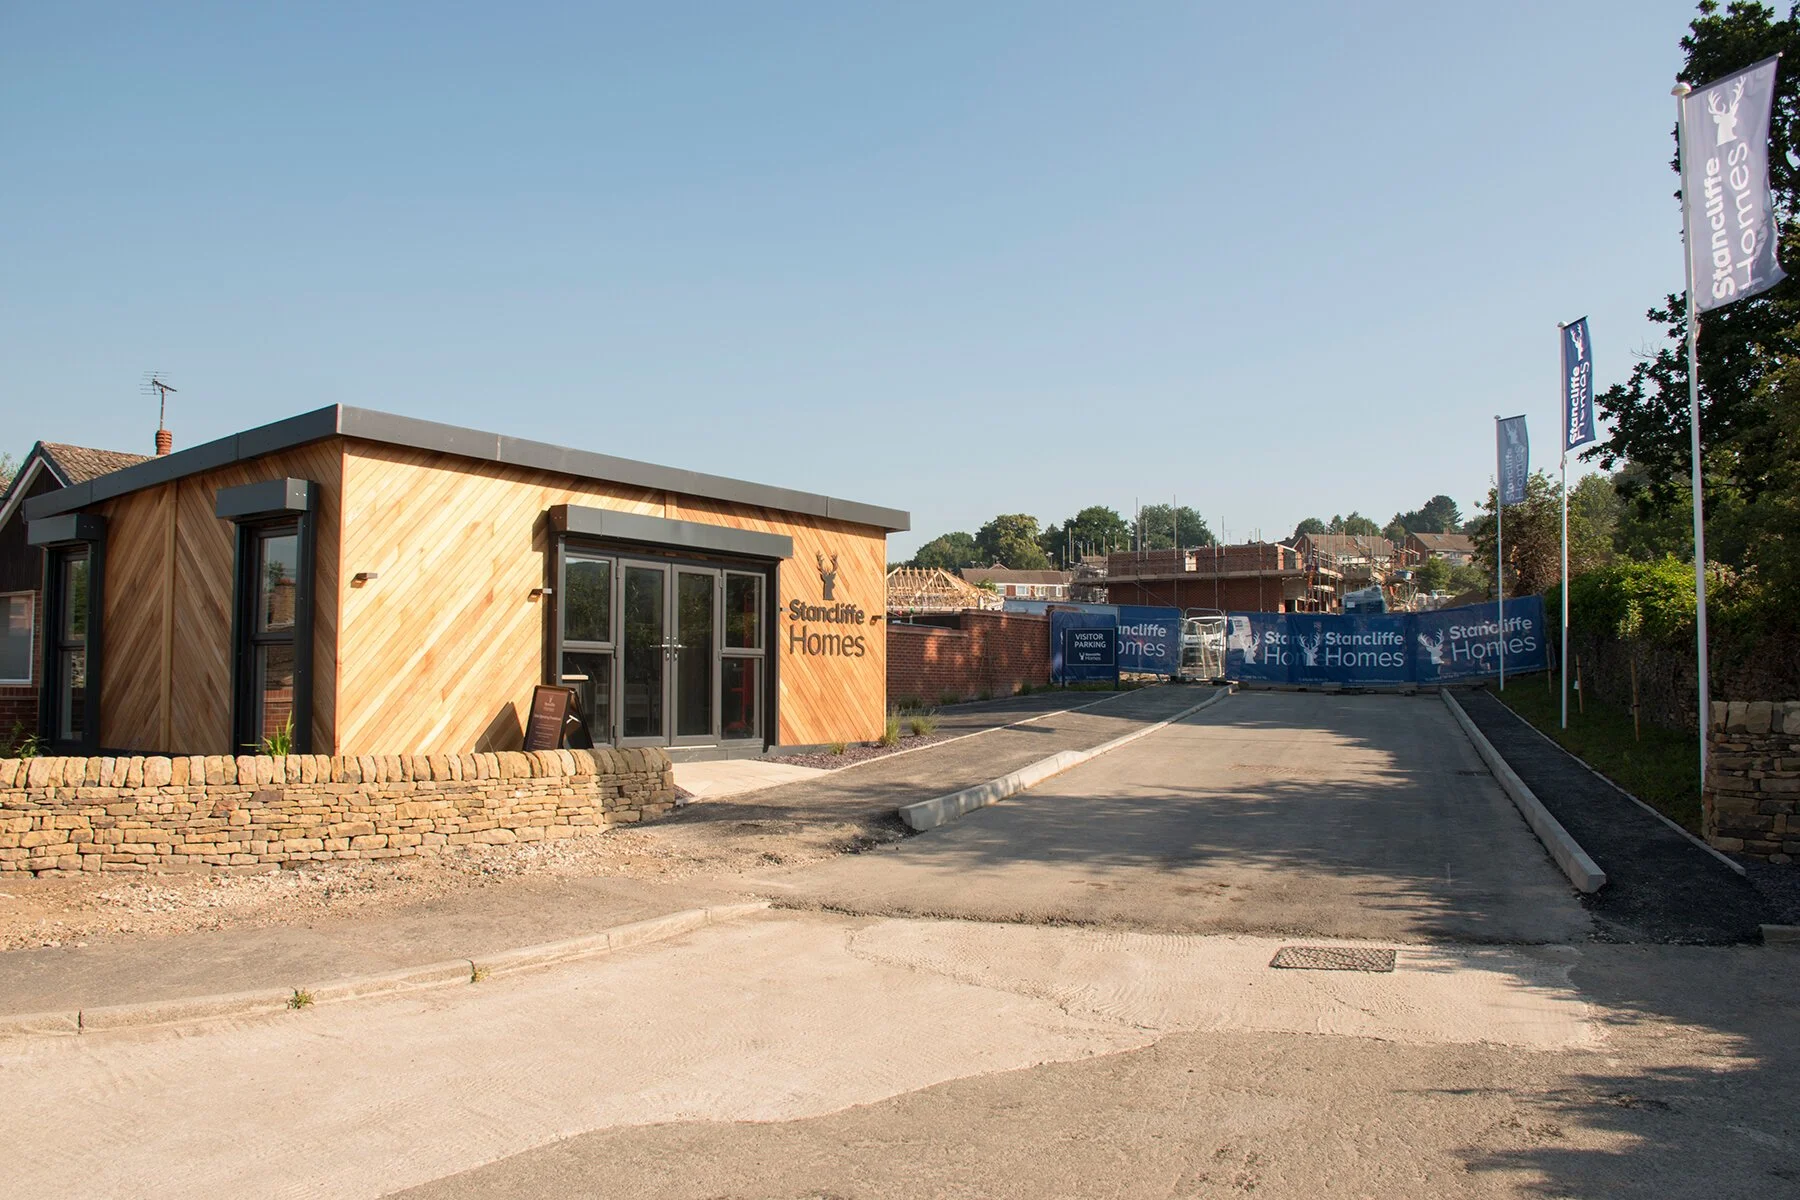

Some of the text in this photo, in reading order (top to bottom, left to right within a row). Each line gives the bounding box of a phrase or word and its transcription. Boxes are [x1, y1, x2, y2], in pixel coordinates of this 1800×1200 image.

[1704, 157, 1736, 299] Stancliffe
[1727, 142, 1764, 290] Homes
[1569, 366, 1580, 444] Stancliffe
[789, 599, 865, 625] Stancliffe
[789, 624, 865, 657] Homes
[1325, 631, 1404, 646] Stancliffe
[1451, 636, 1537, 661] Homes
[1325, 647, 1404, 667] Homes
